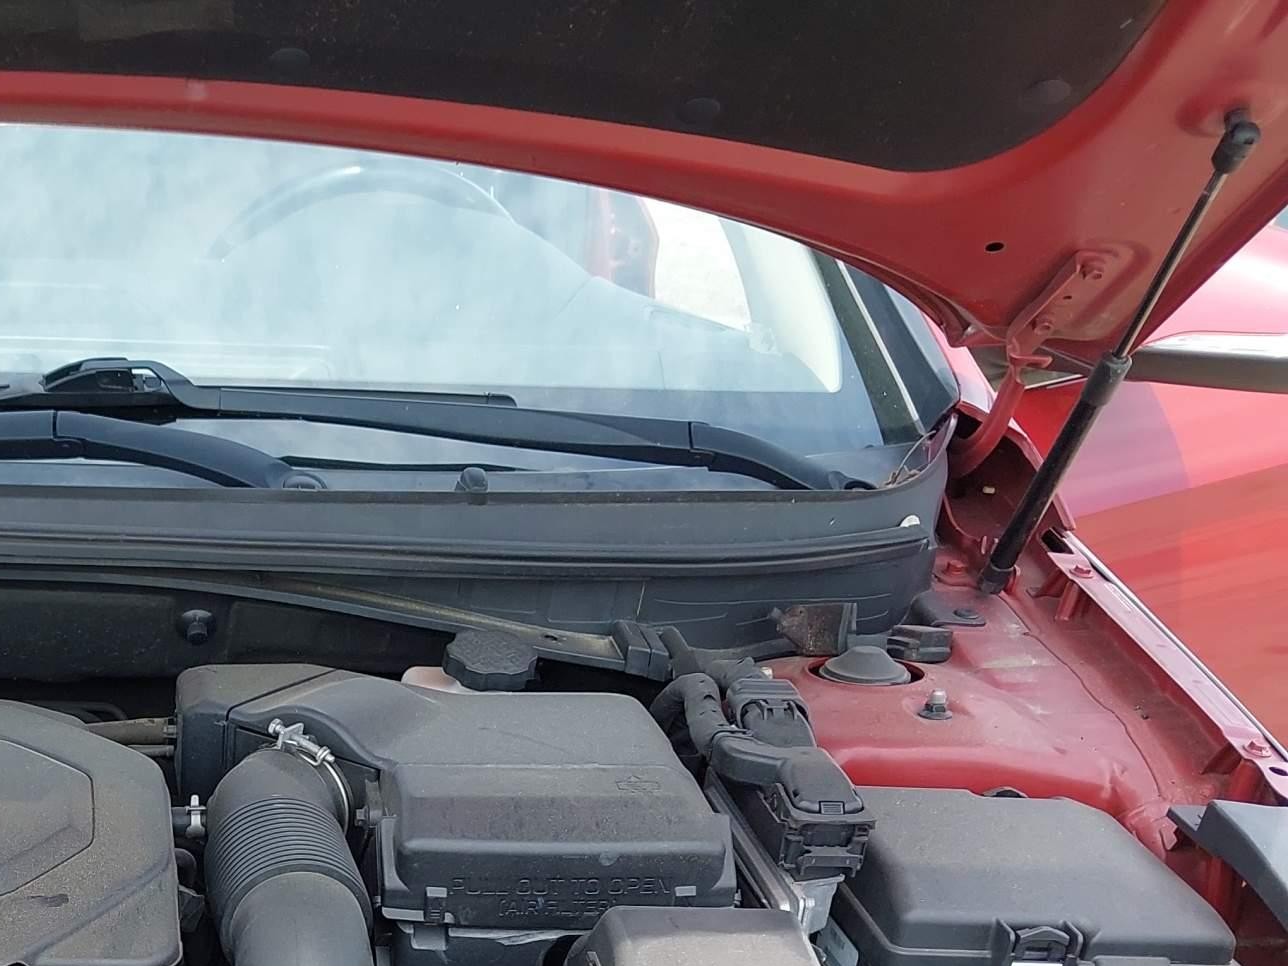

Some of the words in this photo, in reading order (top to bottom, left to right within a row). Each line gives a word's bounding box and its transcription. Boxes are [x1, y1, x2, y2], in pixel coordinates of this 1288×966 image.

[449, 877, 509, 895] PULL
[515, 877, 566, 895] OUT
[570, 877, 601, 895] TO
[607, 877, 672, 895] OPEN
